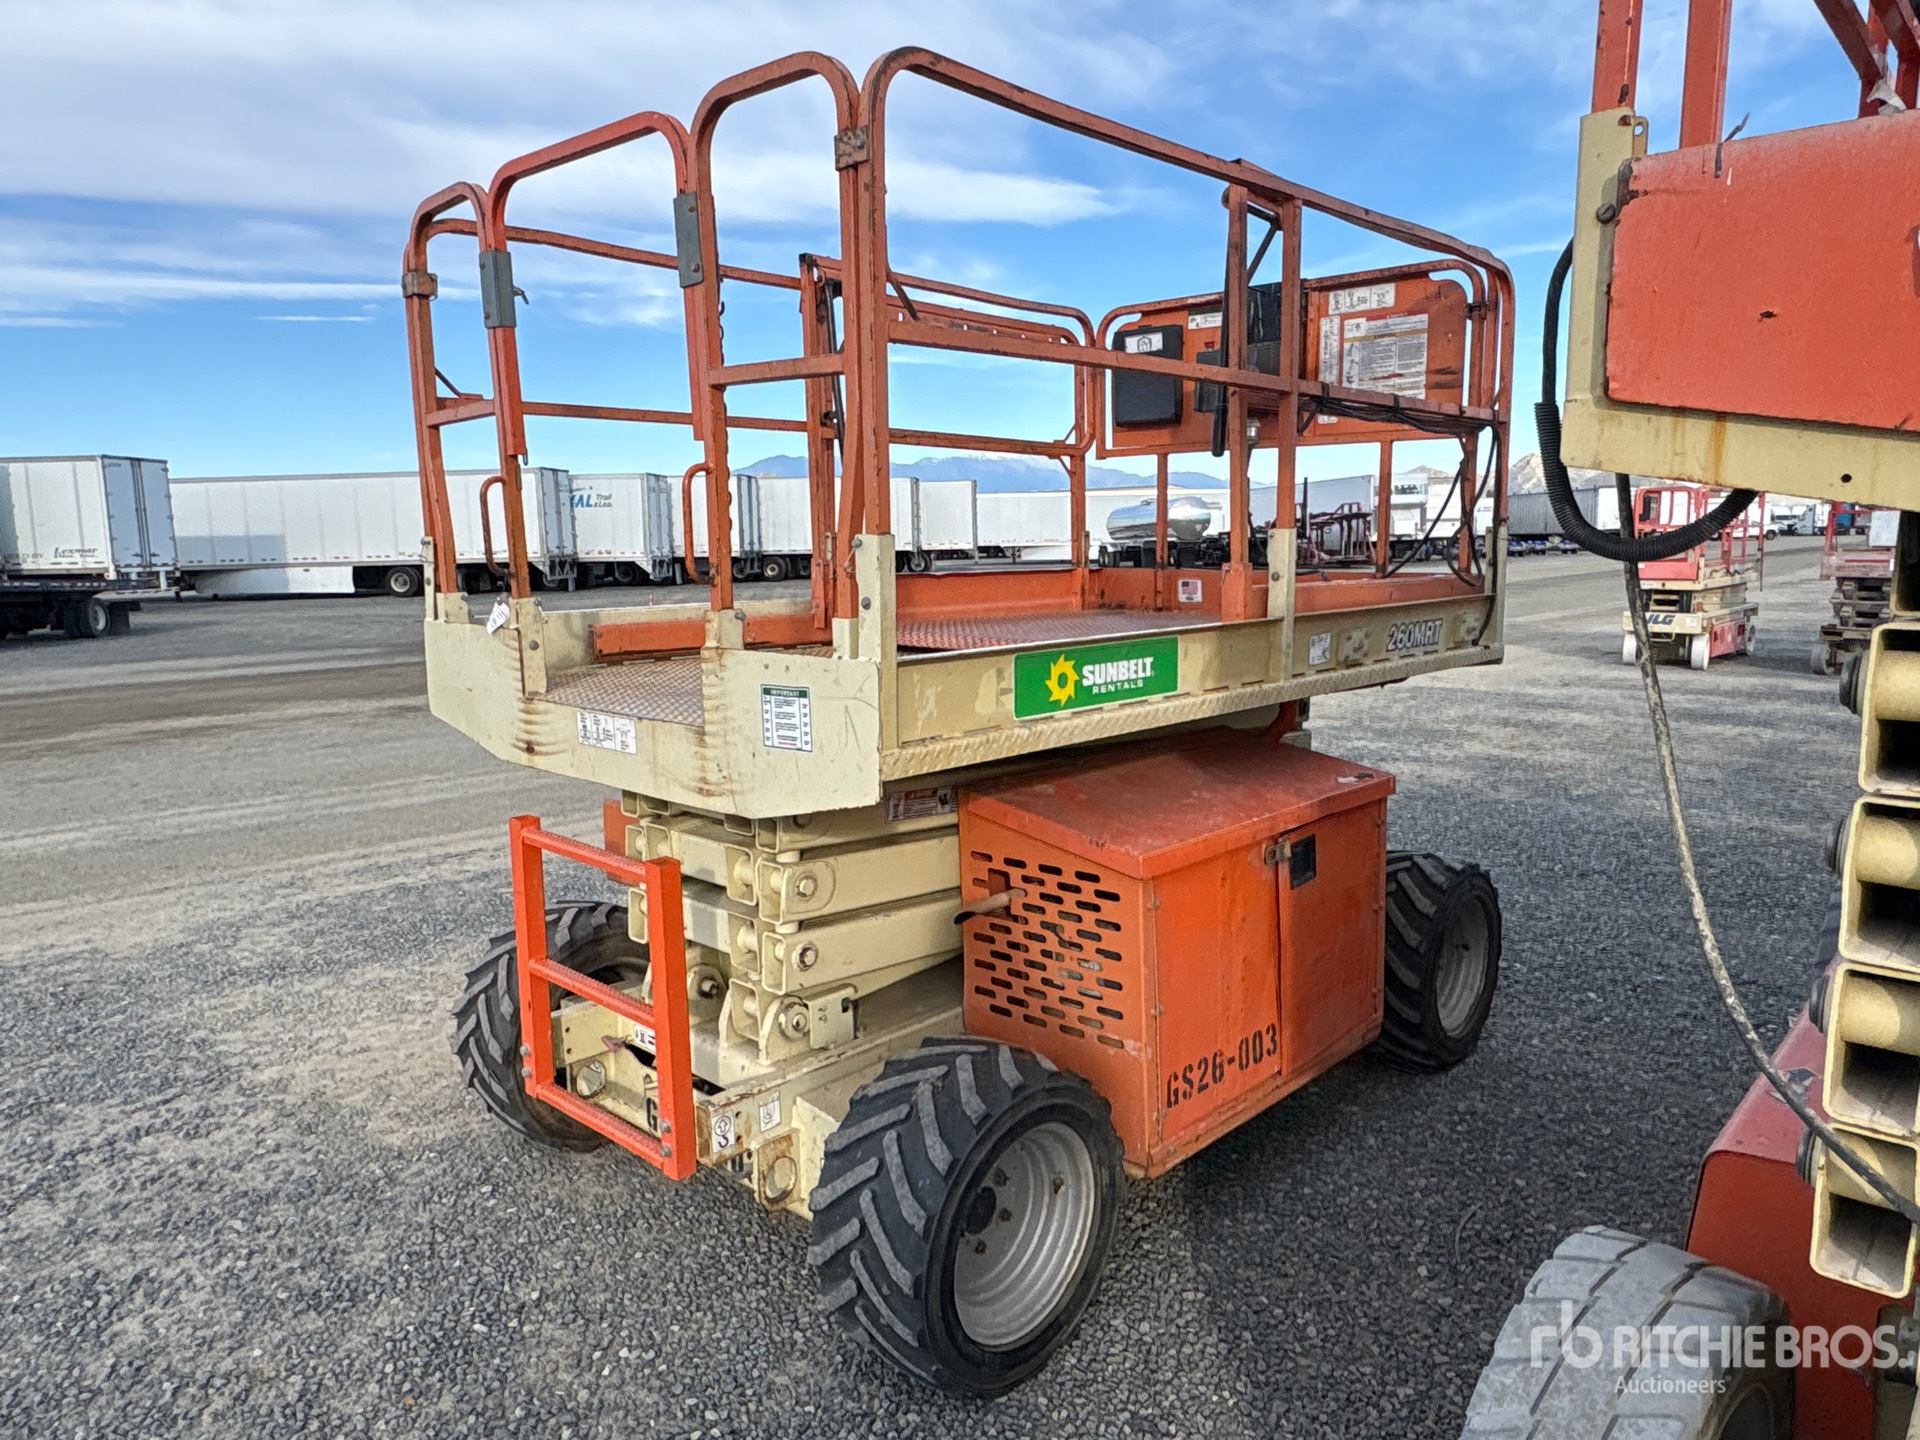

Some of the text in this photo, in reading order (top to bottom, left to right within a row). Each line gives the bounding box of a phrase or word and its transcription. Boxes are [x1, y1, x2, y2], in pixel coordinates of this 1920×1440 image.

[1385, 618, 1443, 653] 260MRT
[1082, 656, 1154, 687] SUNBELT
[1092, 679, 1144, 695] RENTALS
[1166, 1022, 1278, 1109] GS26-003
